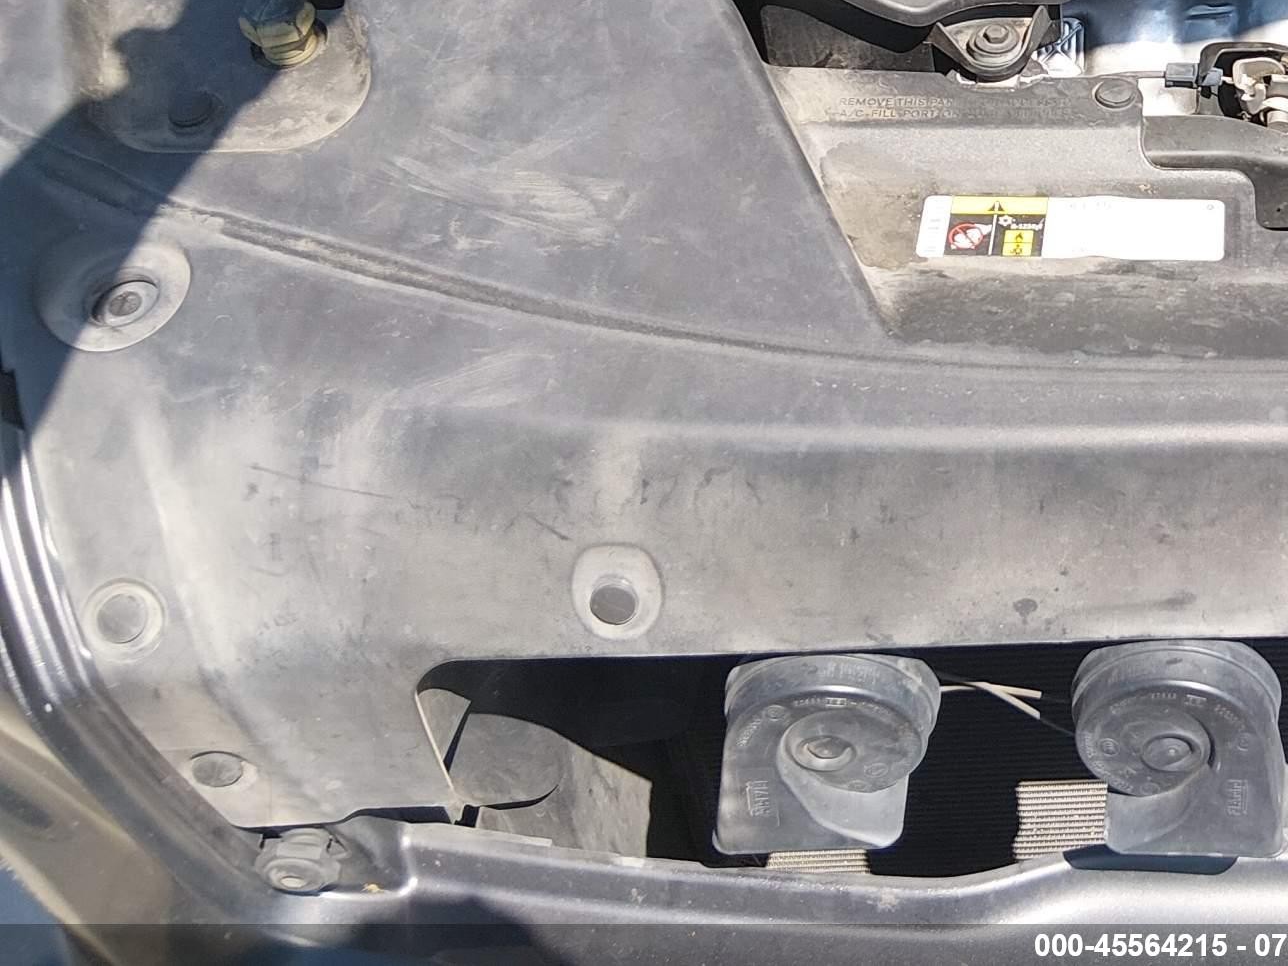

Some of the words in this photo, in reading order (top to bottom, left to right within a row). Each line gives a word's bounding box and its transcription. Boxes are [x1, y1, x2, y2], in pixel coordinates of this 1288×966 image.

[839, 97, 895, 107] REMOVE
[896, 97, 927, 107] THIS
[871, 109, 897, 118] FILL
